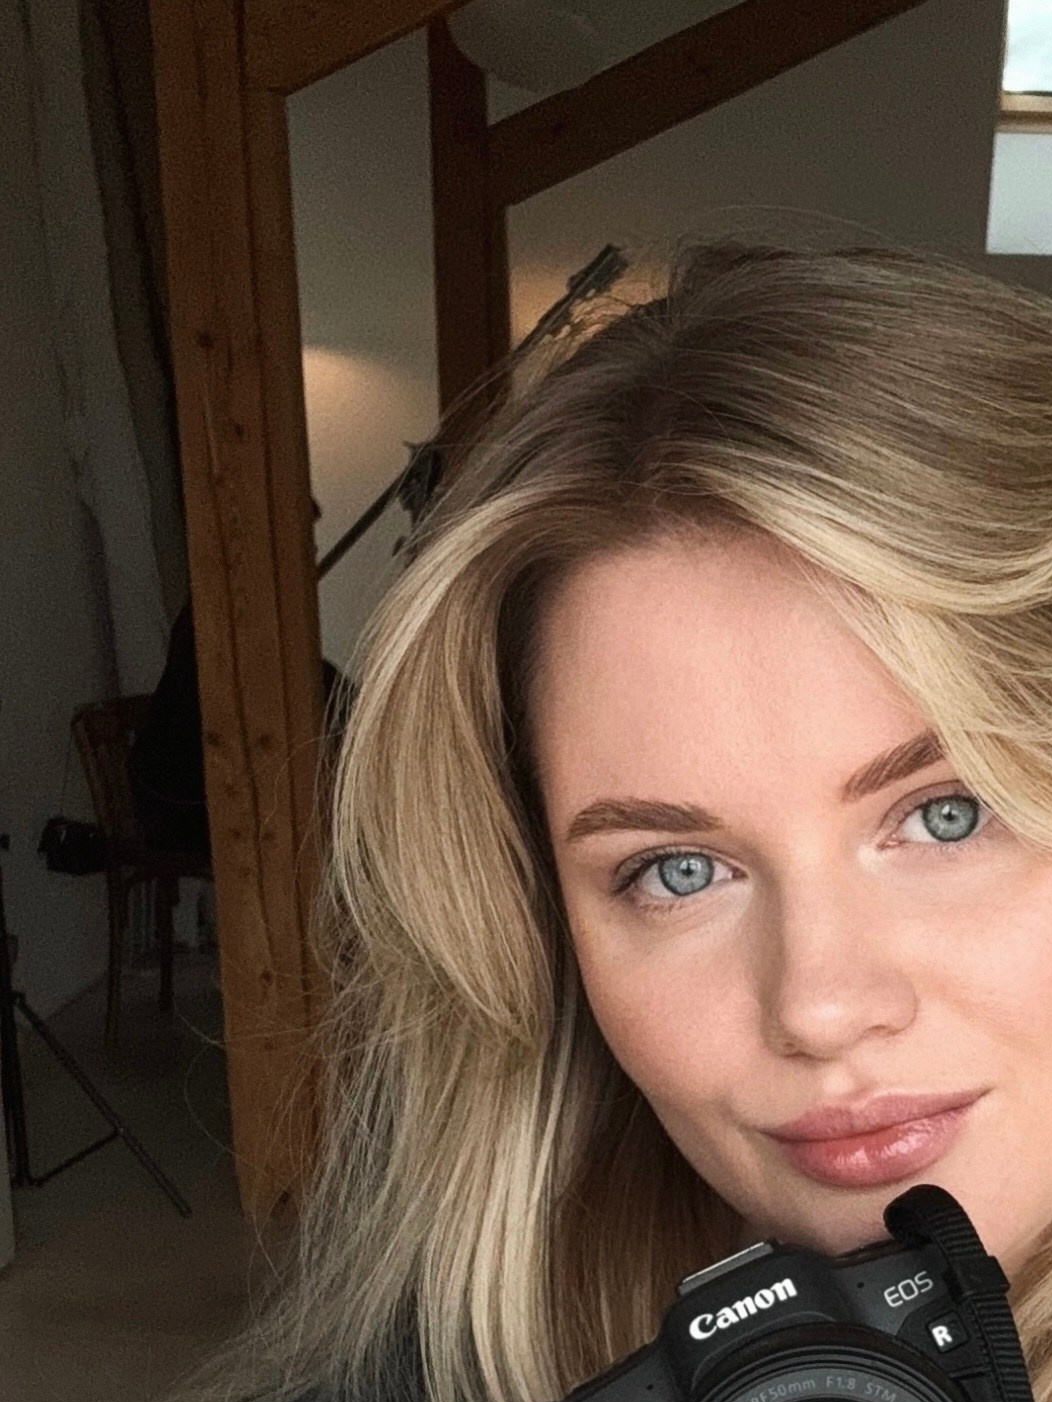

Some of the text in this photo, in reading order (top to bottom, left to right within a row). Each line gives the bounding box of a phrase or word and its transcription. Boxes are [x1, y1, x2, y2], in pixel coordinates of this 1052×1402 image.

[884, 1271, 933, 1308] EOS
[689, 1278, 797, 1340] Canon
[931, 1325, 953, 1347] R
[826, 1375, 856, 1390] F1.8
